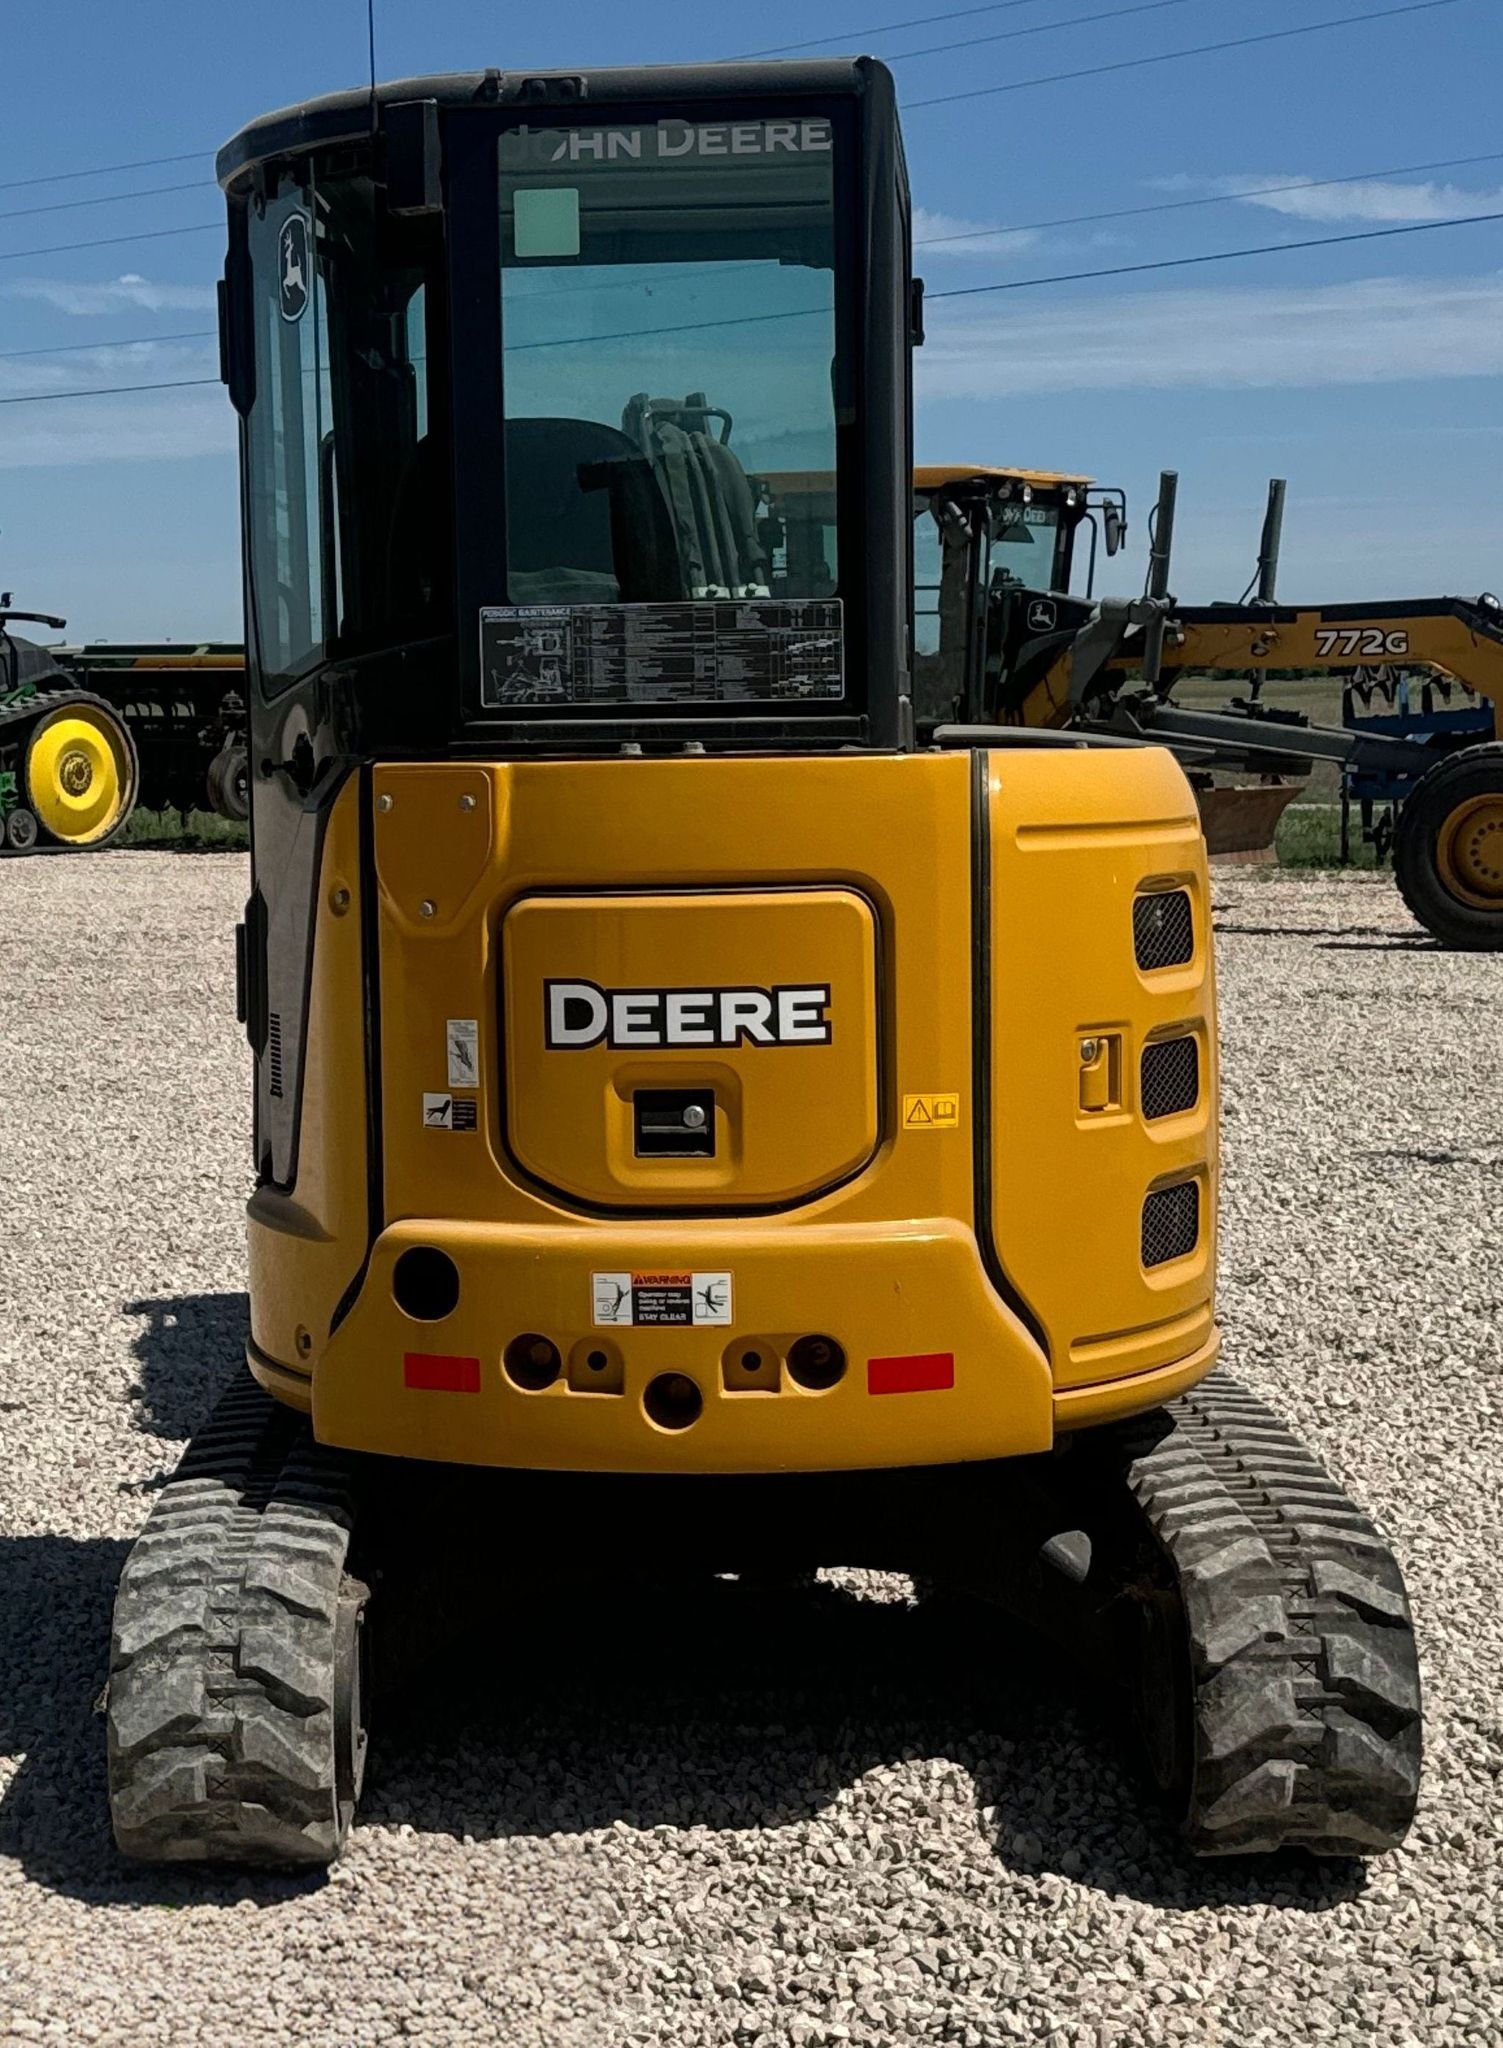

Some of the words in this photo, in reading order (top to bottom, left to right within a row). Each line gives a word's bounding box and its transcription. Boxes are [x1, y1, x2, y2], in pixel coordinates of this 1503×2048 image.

[657, 118, 832, 158] DEERE
[1315, 628, 1408, 655] 772G
[547, 983, 828, 1046] DEERE
[643, 1275, 690, 1285] WARNING
[660, 1313, 687, 1321] CLEAR
